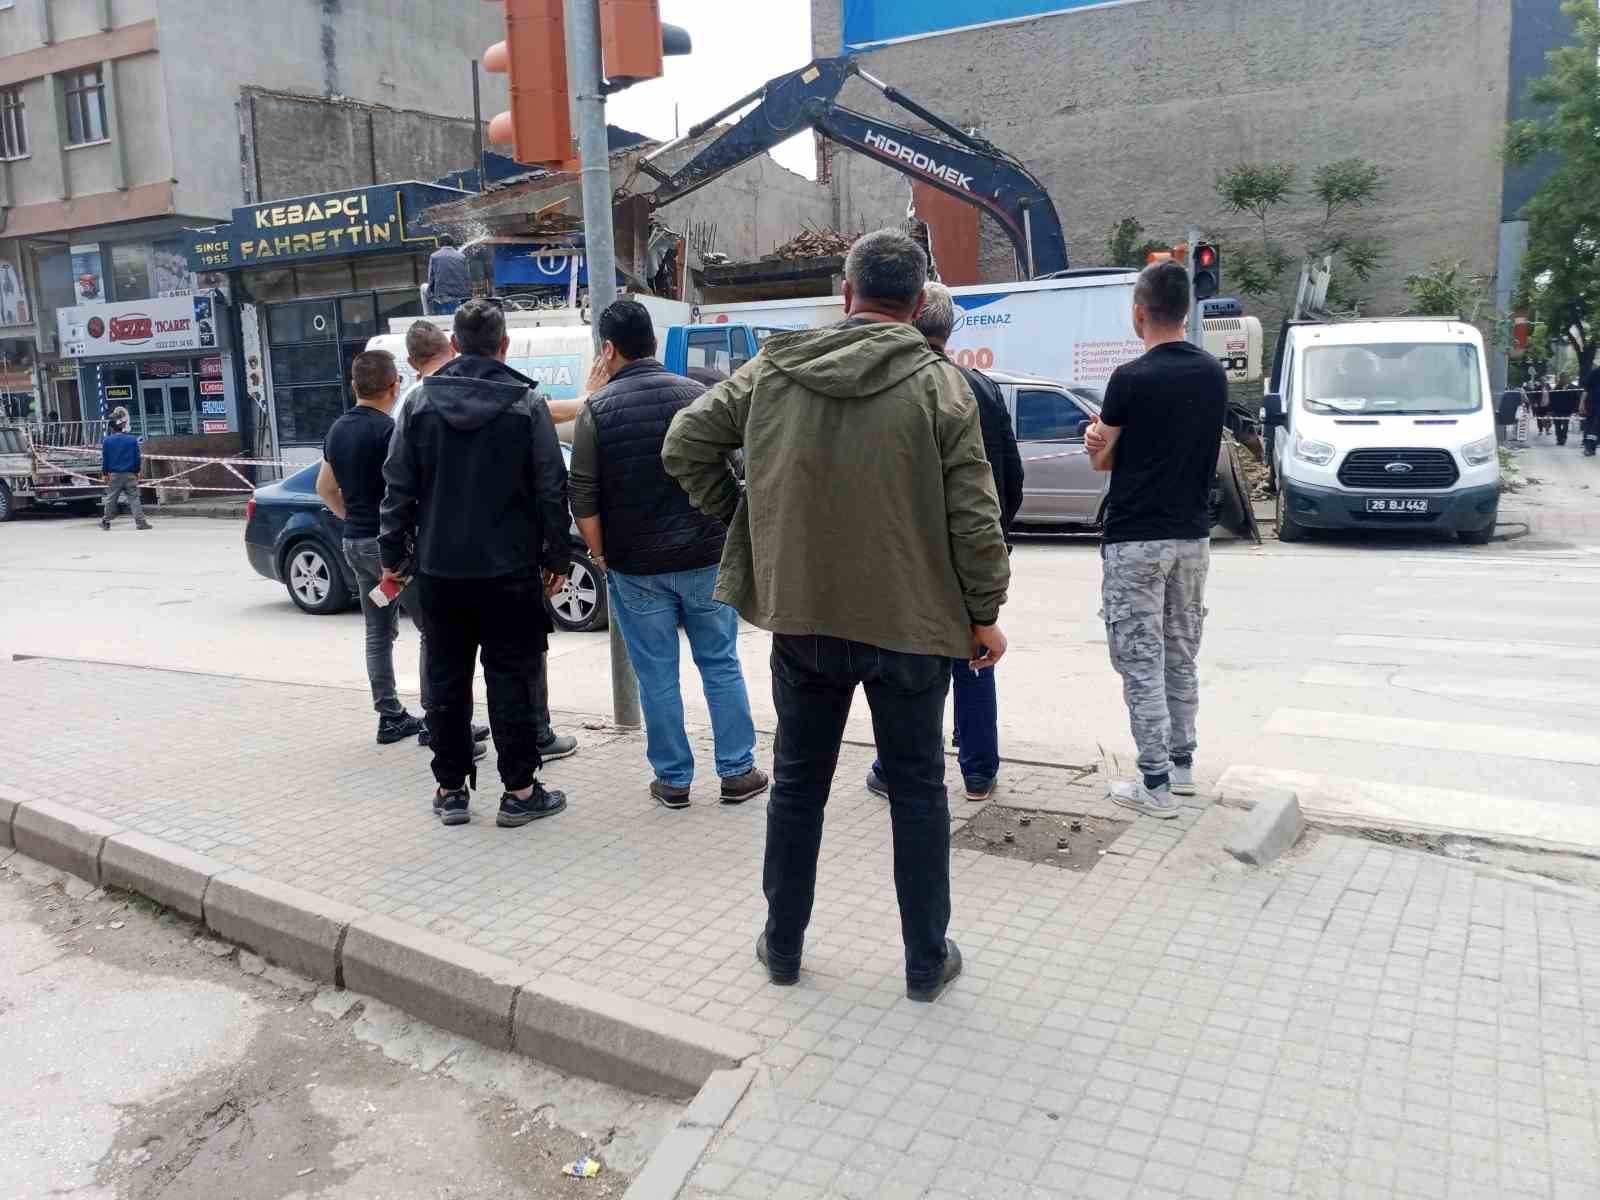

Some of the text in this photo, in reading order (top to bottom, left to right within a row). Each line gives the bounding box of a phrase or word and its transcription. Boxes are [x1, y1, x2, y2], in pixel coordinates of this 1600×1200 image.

[254, 194, 368, 229] KEBAPÇI
[240, 219, 390, 260] FAHRETTİN
[194, 240, 229, 254] SINCE
[200, 254, 230, 264] 1955
[966, 313, 1010, 326] EFENAZ
